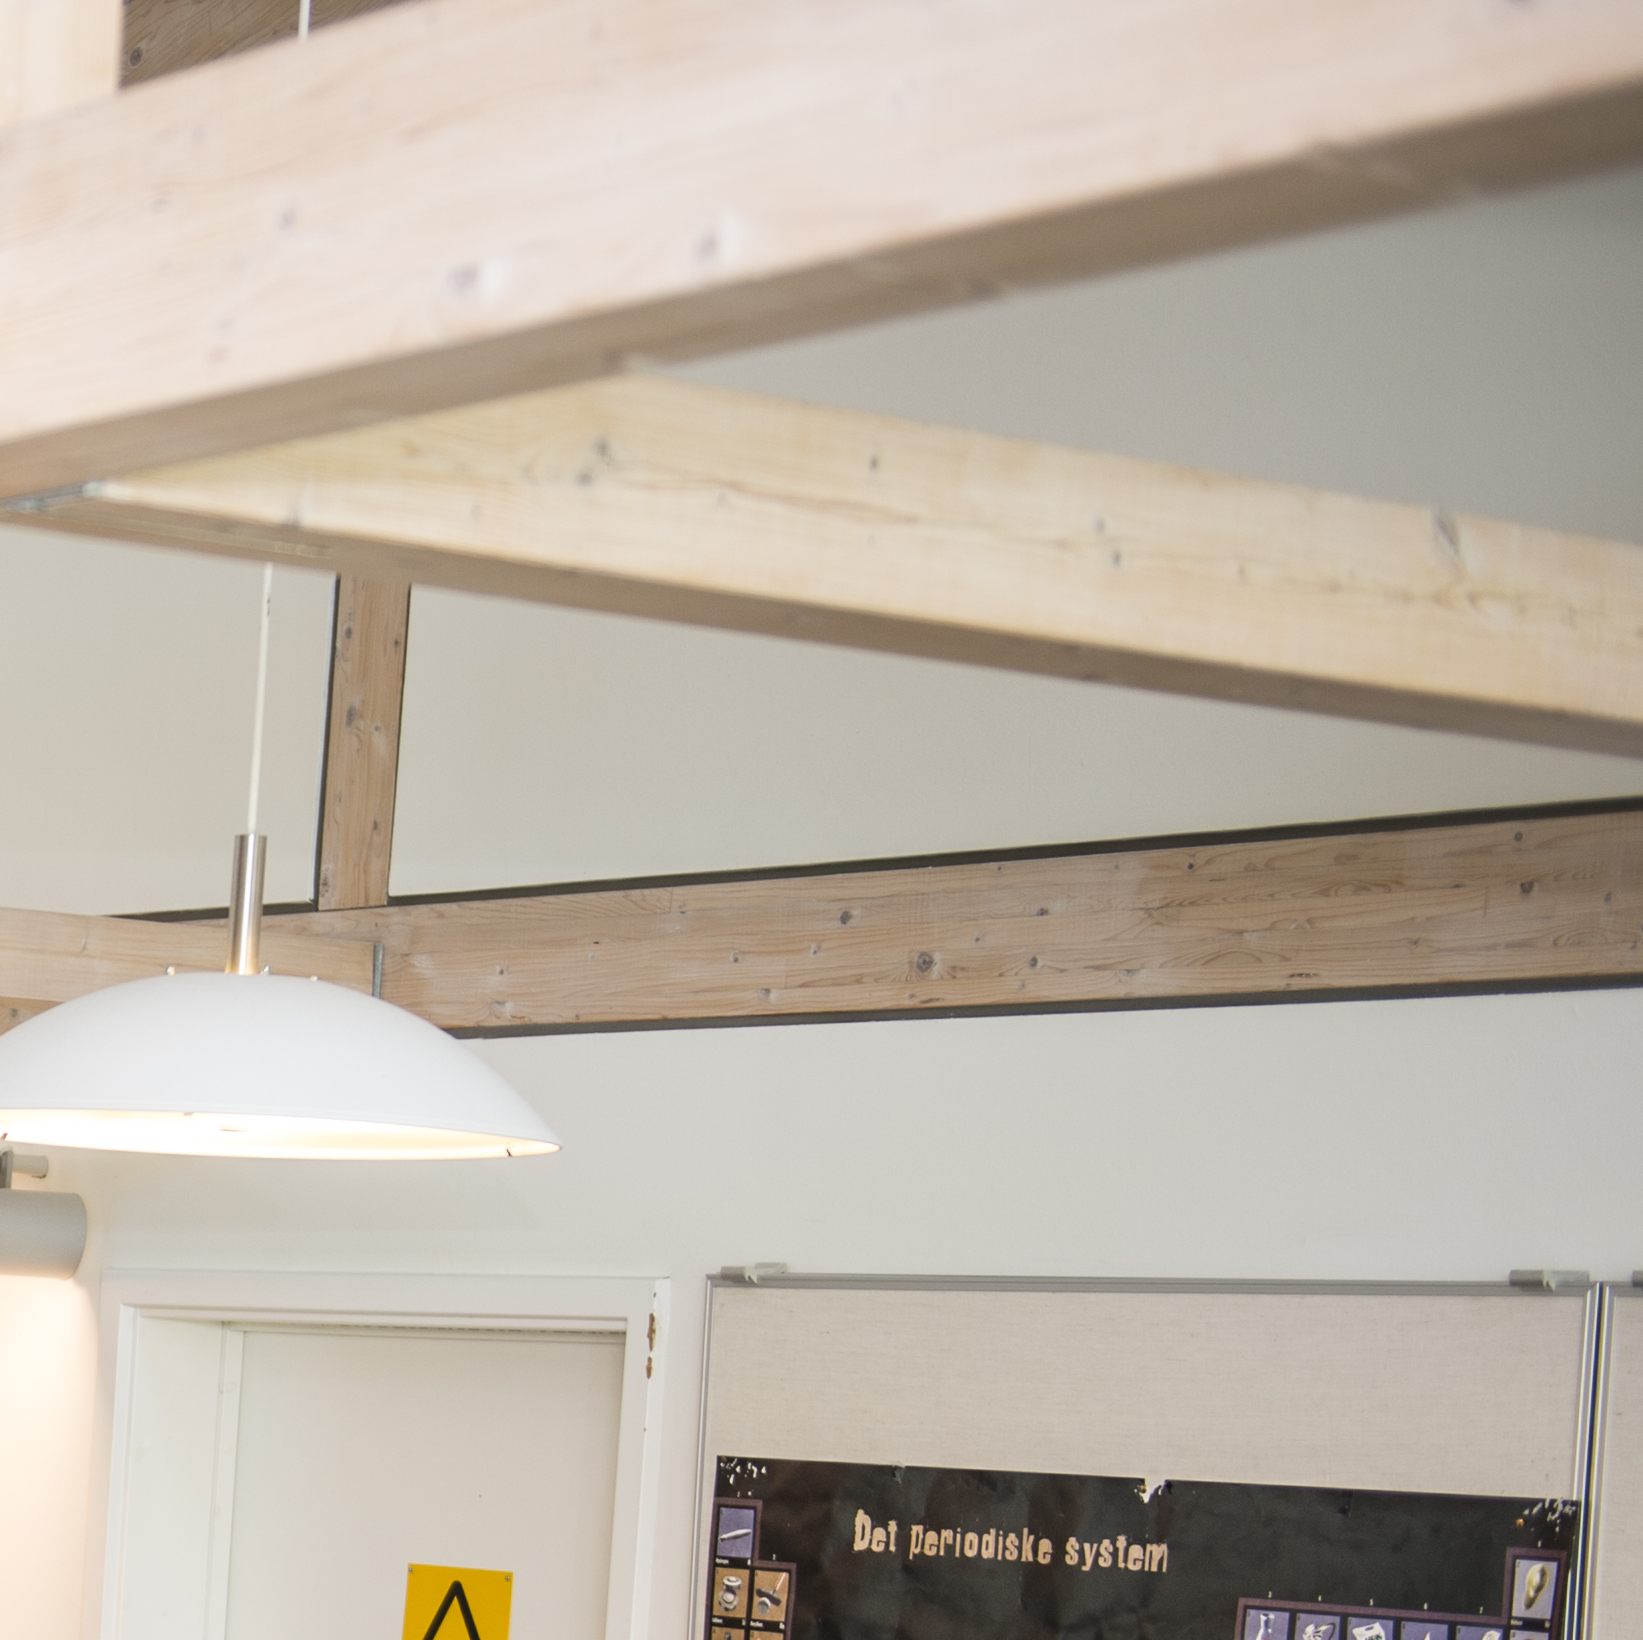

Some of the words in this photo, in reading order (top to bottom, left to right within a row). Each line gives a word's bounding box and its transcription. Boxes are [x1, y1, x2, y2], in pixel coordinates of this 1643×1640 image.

[853, 1508, 898, 1553] Det
[909, 1523, 1054, 1565] periodiske
[1065, 1534, 1169, 1573] system
